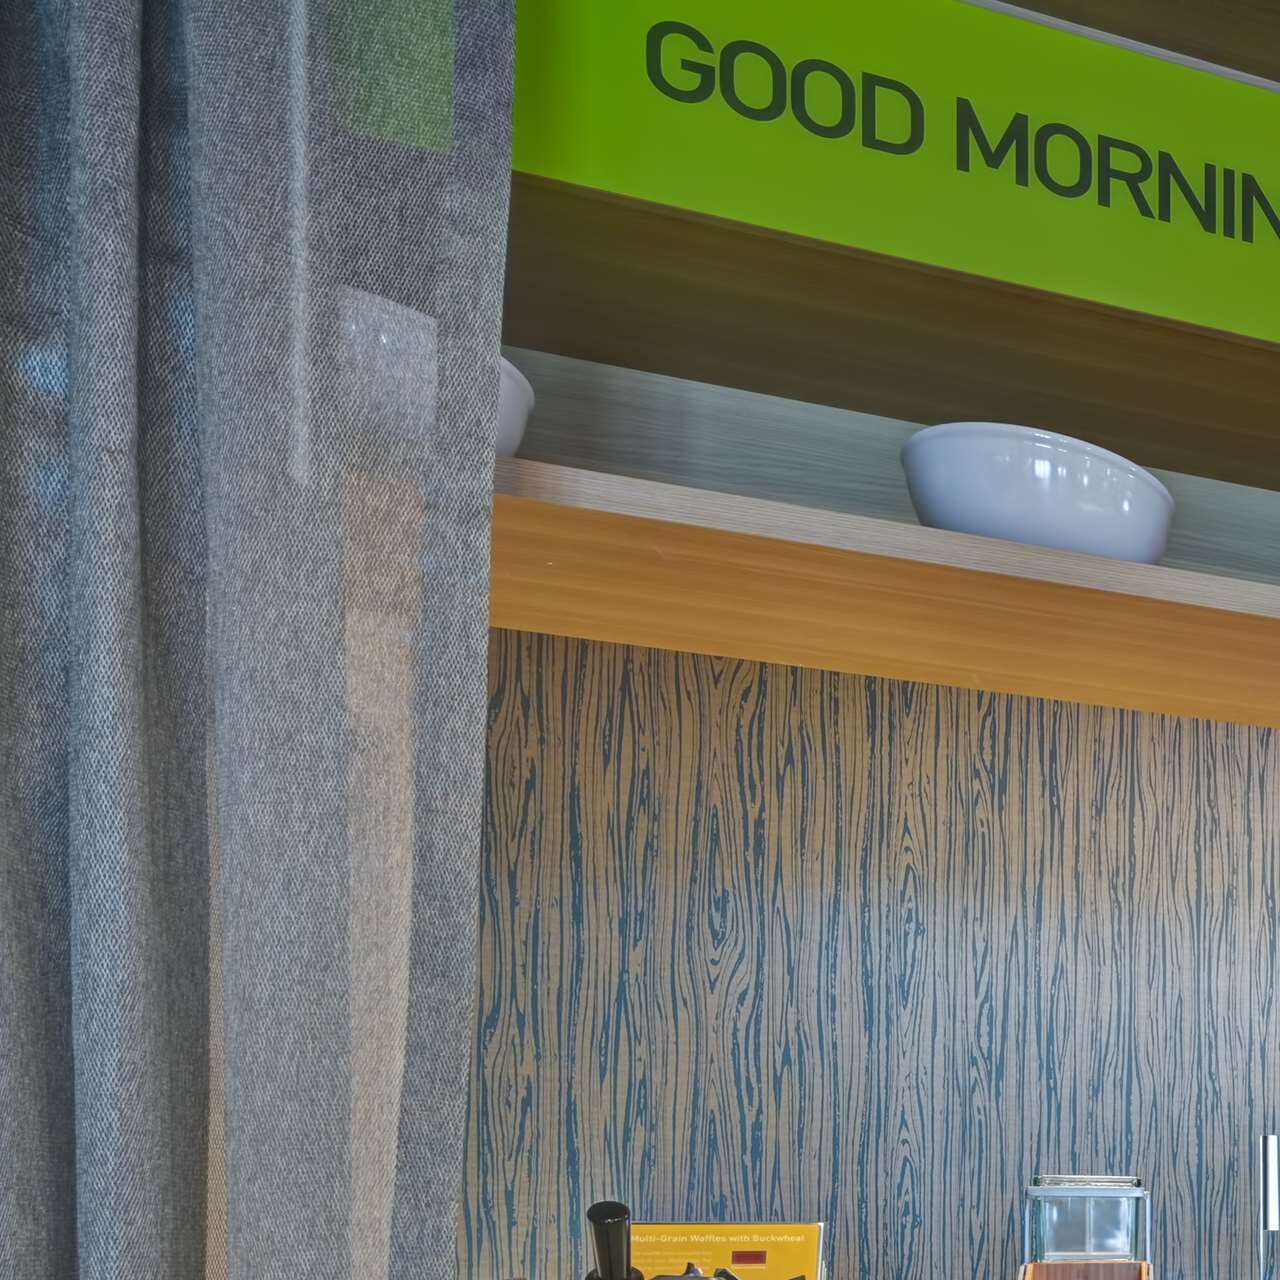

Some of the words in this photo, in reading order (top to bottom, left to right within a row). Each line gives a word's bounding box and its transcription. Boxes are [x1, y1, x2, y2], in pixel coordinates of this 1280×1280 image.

[646, 20, 925, 156] GOOD
[631, 1234, 687, 1243] Multi-Grain
[690, 1234, 727, 1243] Waffles
[728, 1233, 750, 1243] with
[752, 1233, 806, 1243] Buckwheat
